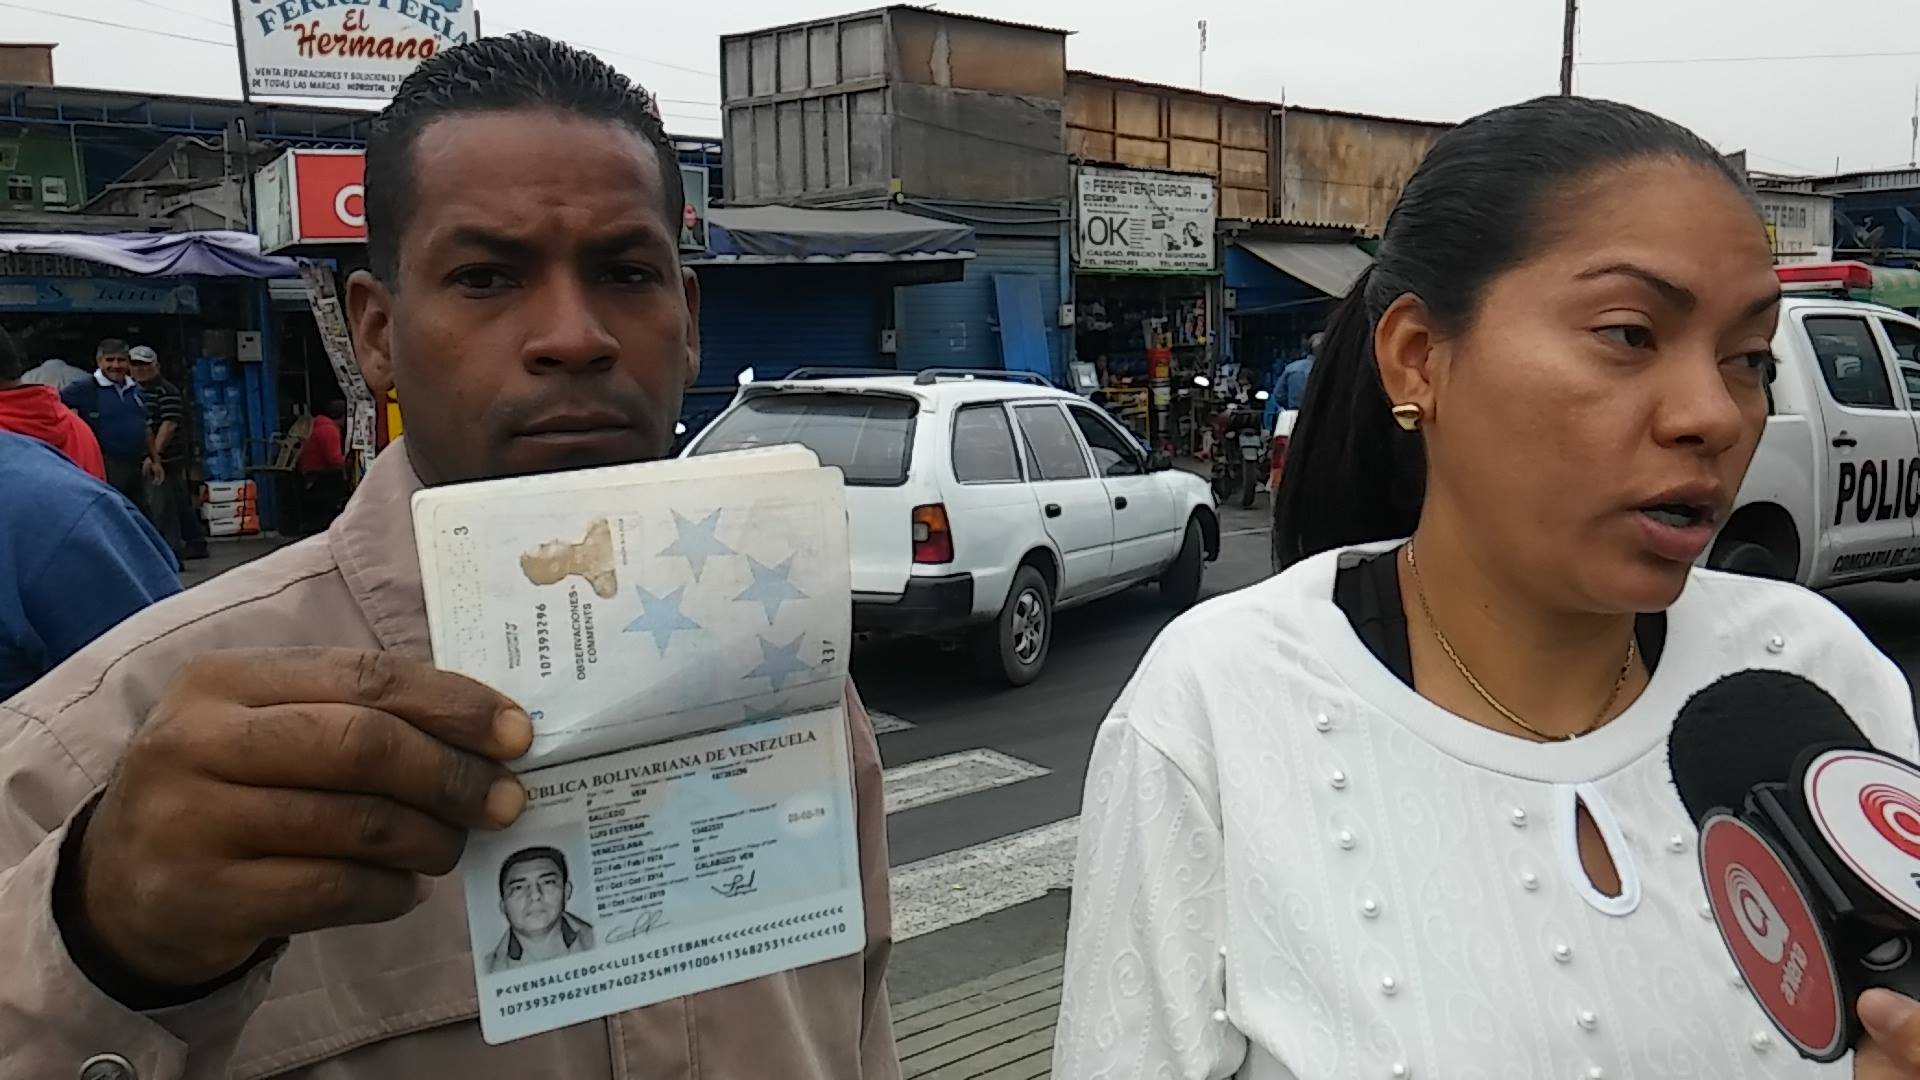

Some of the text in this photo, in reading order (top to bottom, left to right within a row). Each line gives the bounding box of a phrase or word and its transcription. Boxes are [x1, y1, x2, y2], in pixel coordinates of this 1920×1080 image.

[256, 0, 468, 44] FERERIA
[343, 9, 370, 31] El
[252, 78, 262, 88] DE
[264, 79, 290, 89] TODAS
[293, 80, 307, 90] LAS
[309, 81, 341, 91] MARCAS
[255, 67, 281, 77] VENTA
[283, 68, 342, 80] REPARACIONES
[344, 72, 349, 80] Y
[350, 72, 396, 82] SOLUCIONES
[1087, 215, 1129, 246] OK
[453, 525, 469, 536] 3
[536, 603, 552, 678] 107393296
[583, 603, 598, 664] COMMENTS
[592, 755, 701, 787] BOLIVARIANA
[706, 750, 726, 764] DE
[728, 730, 816, 758] VENEZUELA
